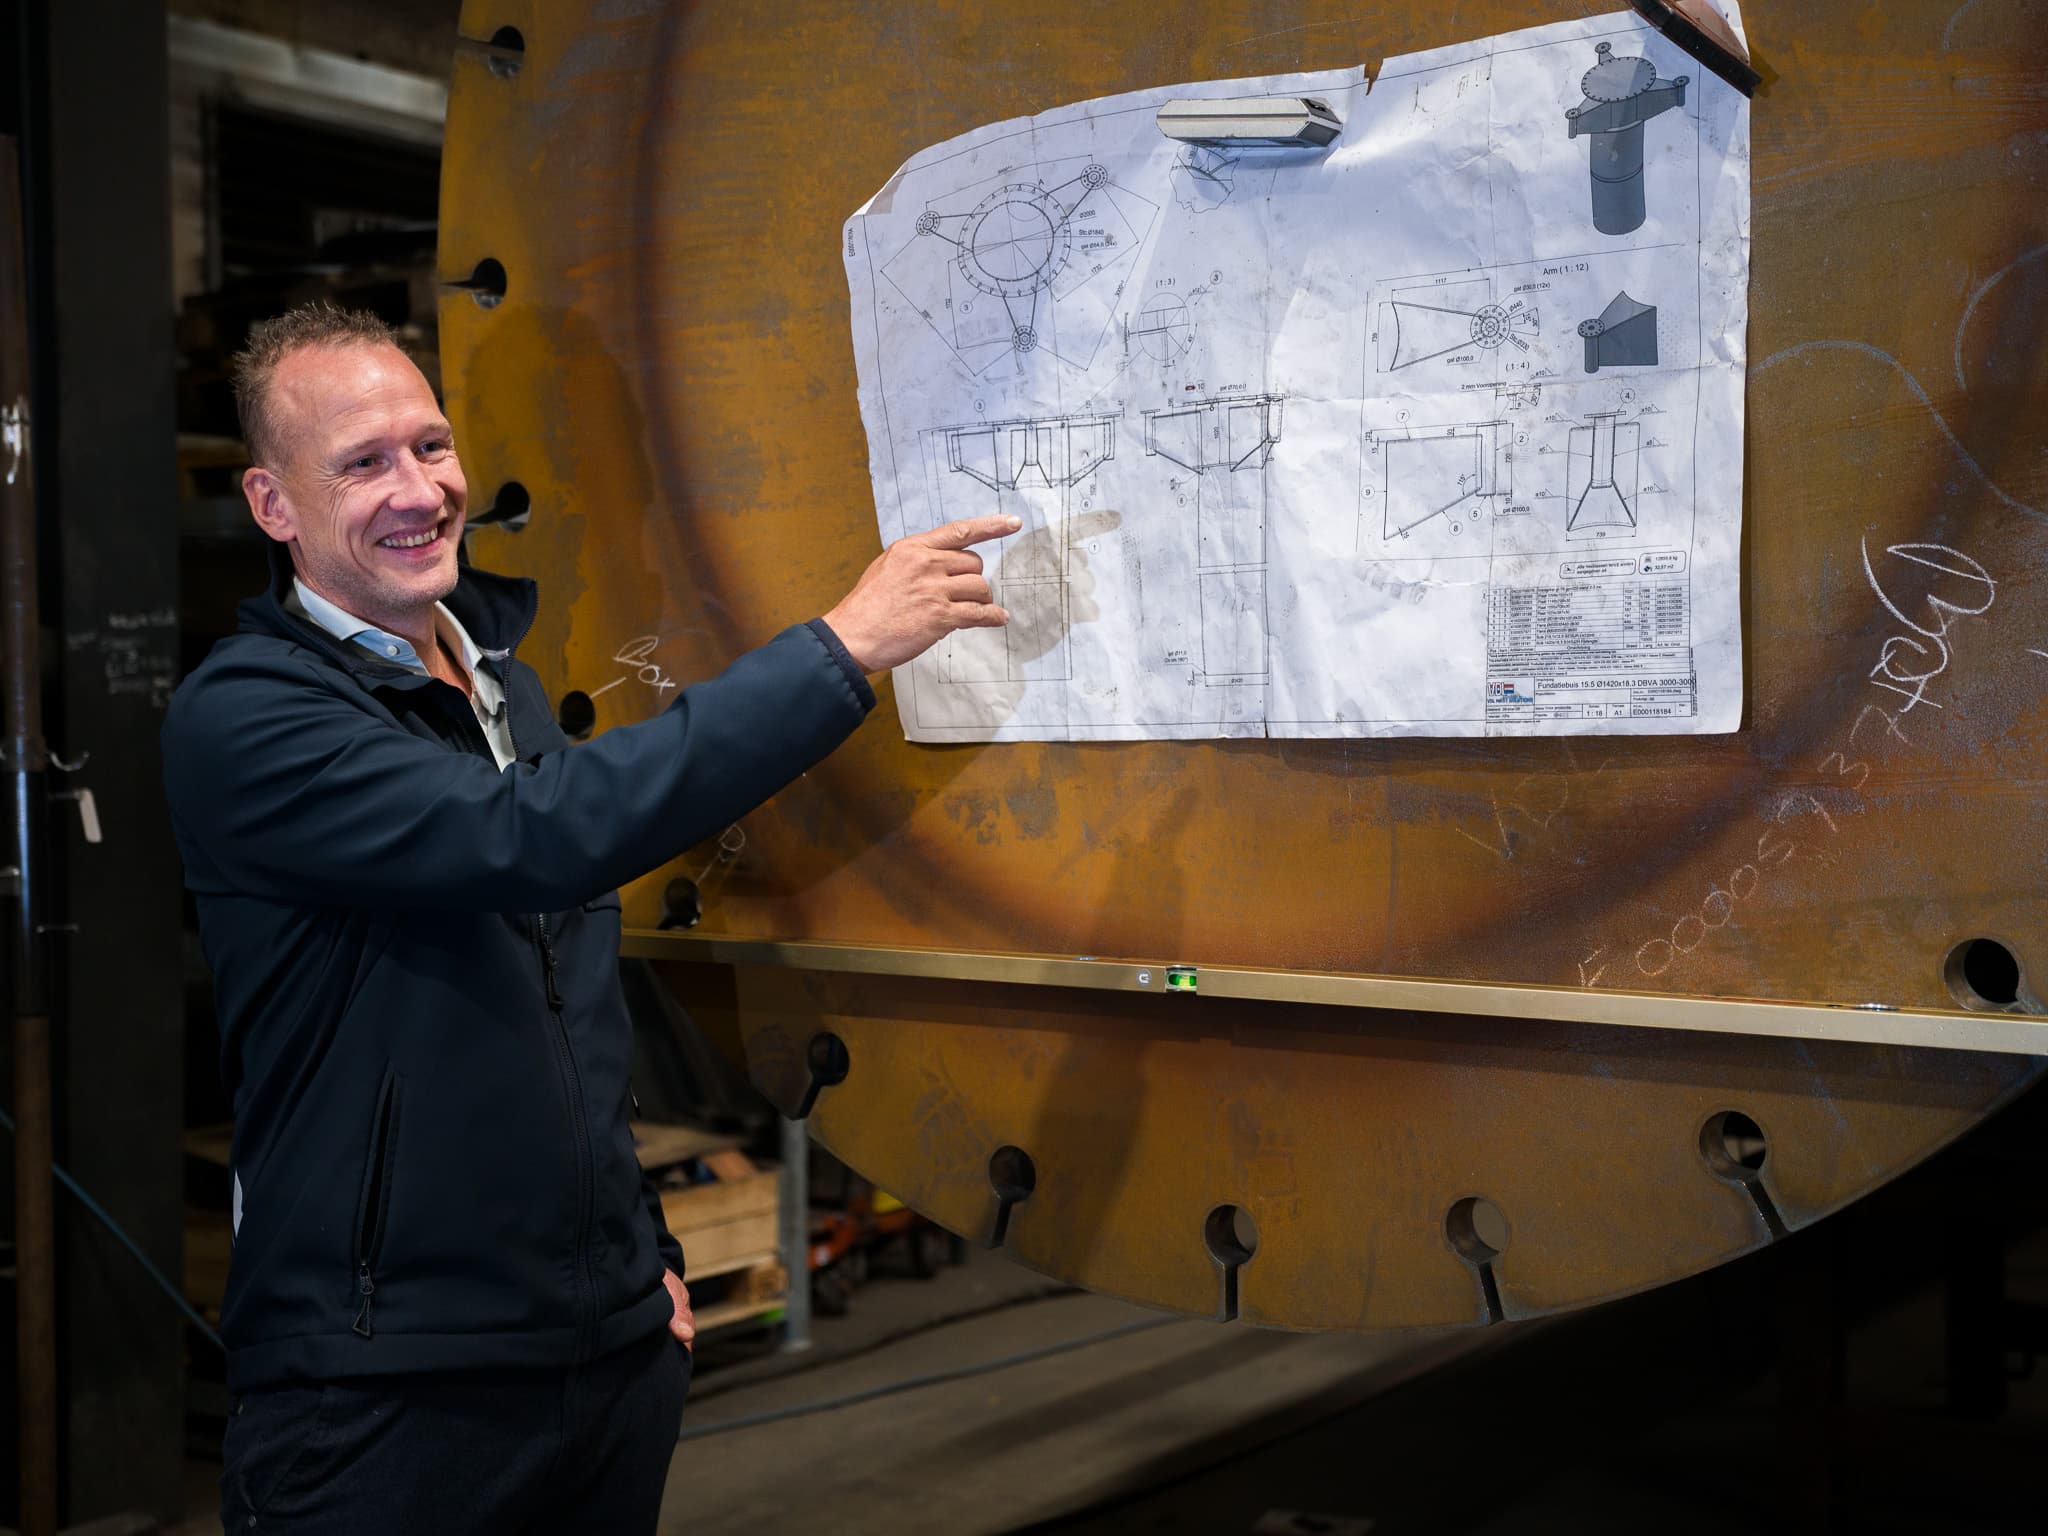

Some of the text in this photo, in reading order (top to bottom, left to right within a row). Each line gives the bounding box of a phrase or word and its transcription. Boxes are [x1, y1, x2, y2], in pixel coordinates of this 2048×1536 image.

[1543, 267, 1558, 276] Arm
[613, 635, 676, 696] Box
[1537, 681, 1579, 689] Fundatiebuis
[1637, 679, 1658, 687] DBVA
[1632, 708, 1672, 716] E000118184
